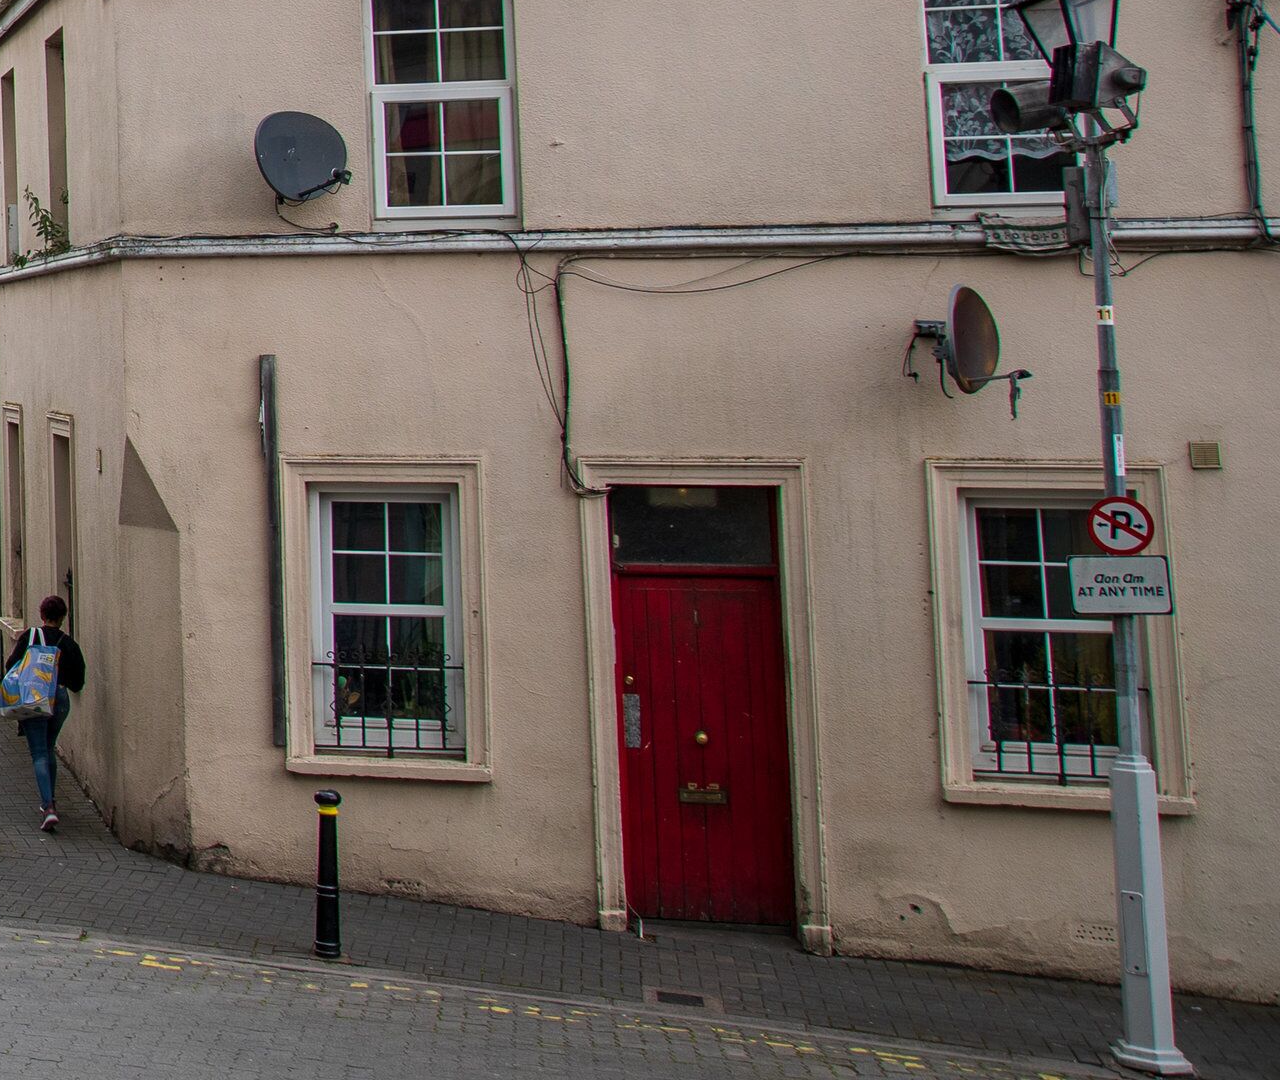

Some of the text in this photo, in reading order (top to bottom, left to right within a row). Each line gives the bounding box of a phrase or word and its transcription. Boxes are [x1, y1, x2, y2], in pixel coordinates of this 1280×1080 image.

[1096, 308, 1112, 320] 11
[1104, 392, 1118, 404] 11
[1077, 585, 1165, 597] AT ANY TIME
